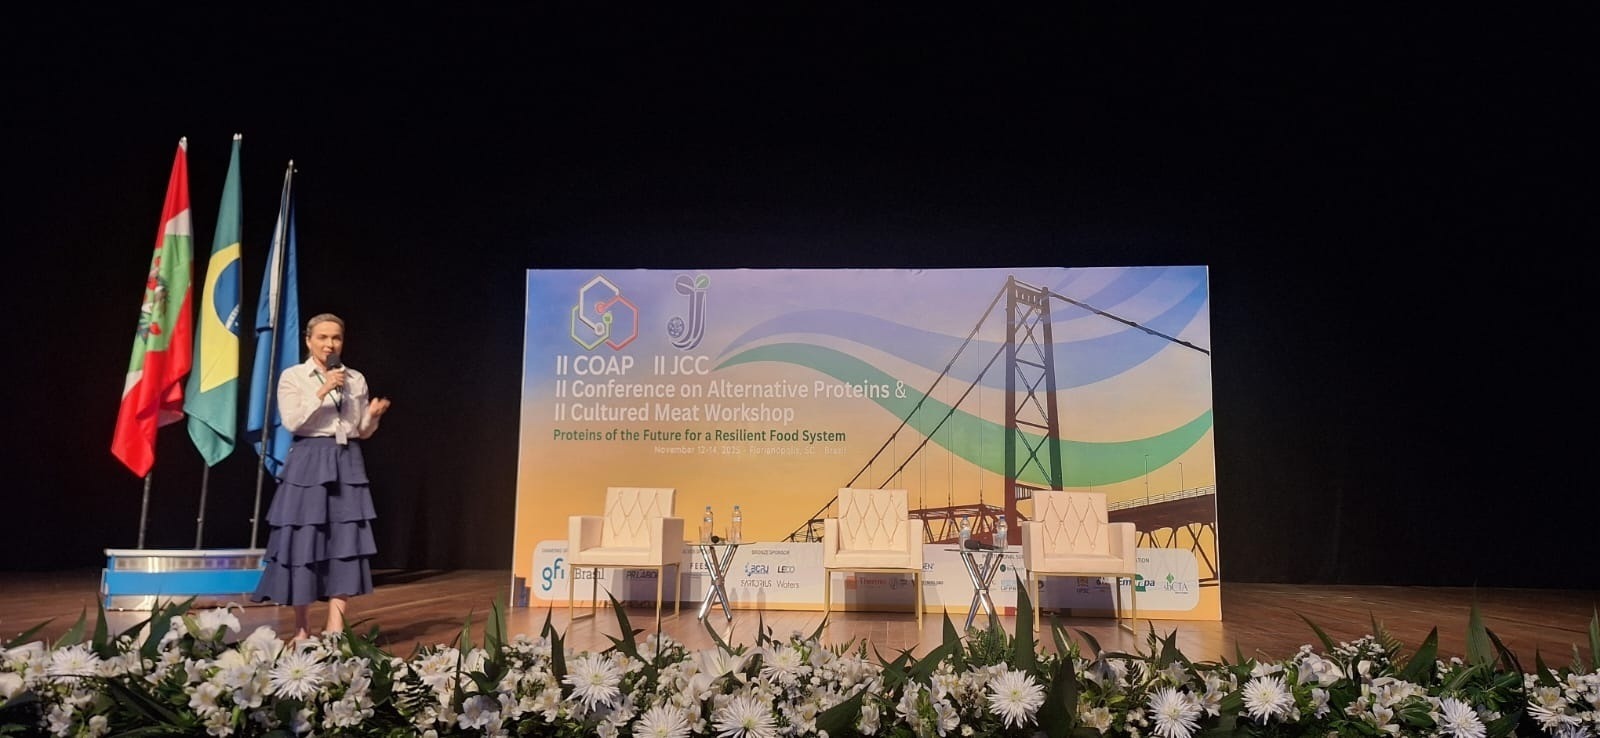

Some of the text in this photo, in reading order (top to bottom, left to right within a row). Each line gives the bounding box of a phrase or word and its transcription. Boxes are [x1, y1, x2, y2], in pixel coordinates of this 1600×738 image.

[556, 355, 634, 376] II COAP
[653, 355, 710, 376] II JCC
[555, 379, 907, 399] II Conference on Alternative Proteins &
[554, 403, 795, 425] II Cultured Meat Workshop
[553, 428, 846, 444] Proteins of the Future for a Resilient Food System
[654, 445, 695, 455] November
[541, 557, 565, 592] gfi
[575, 567, 605, 580] Brail
[1119, 576, 1155, 588] Emrapa
